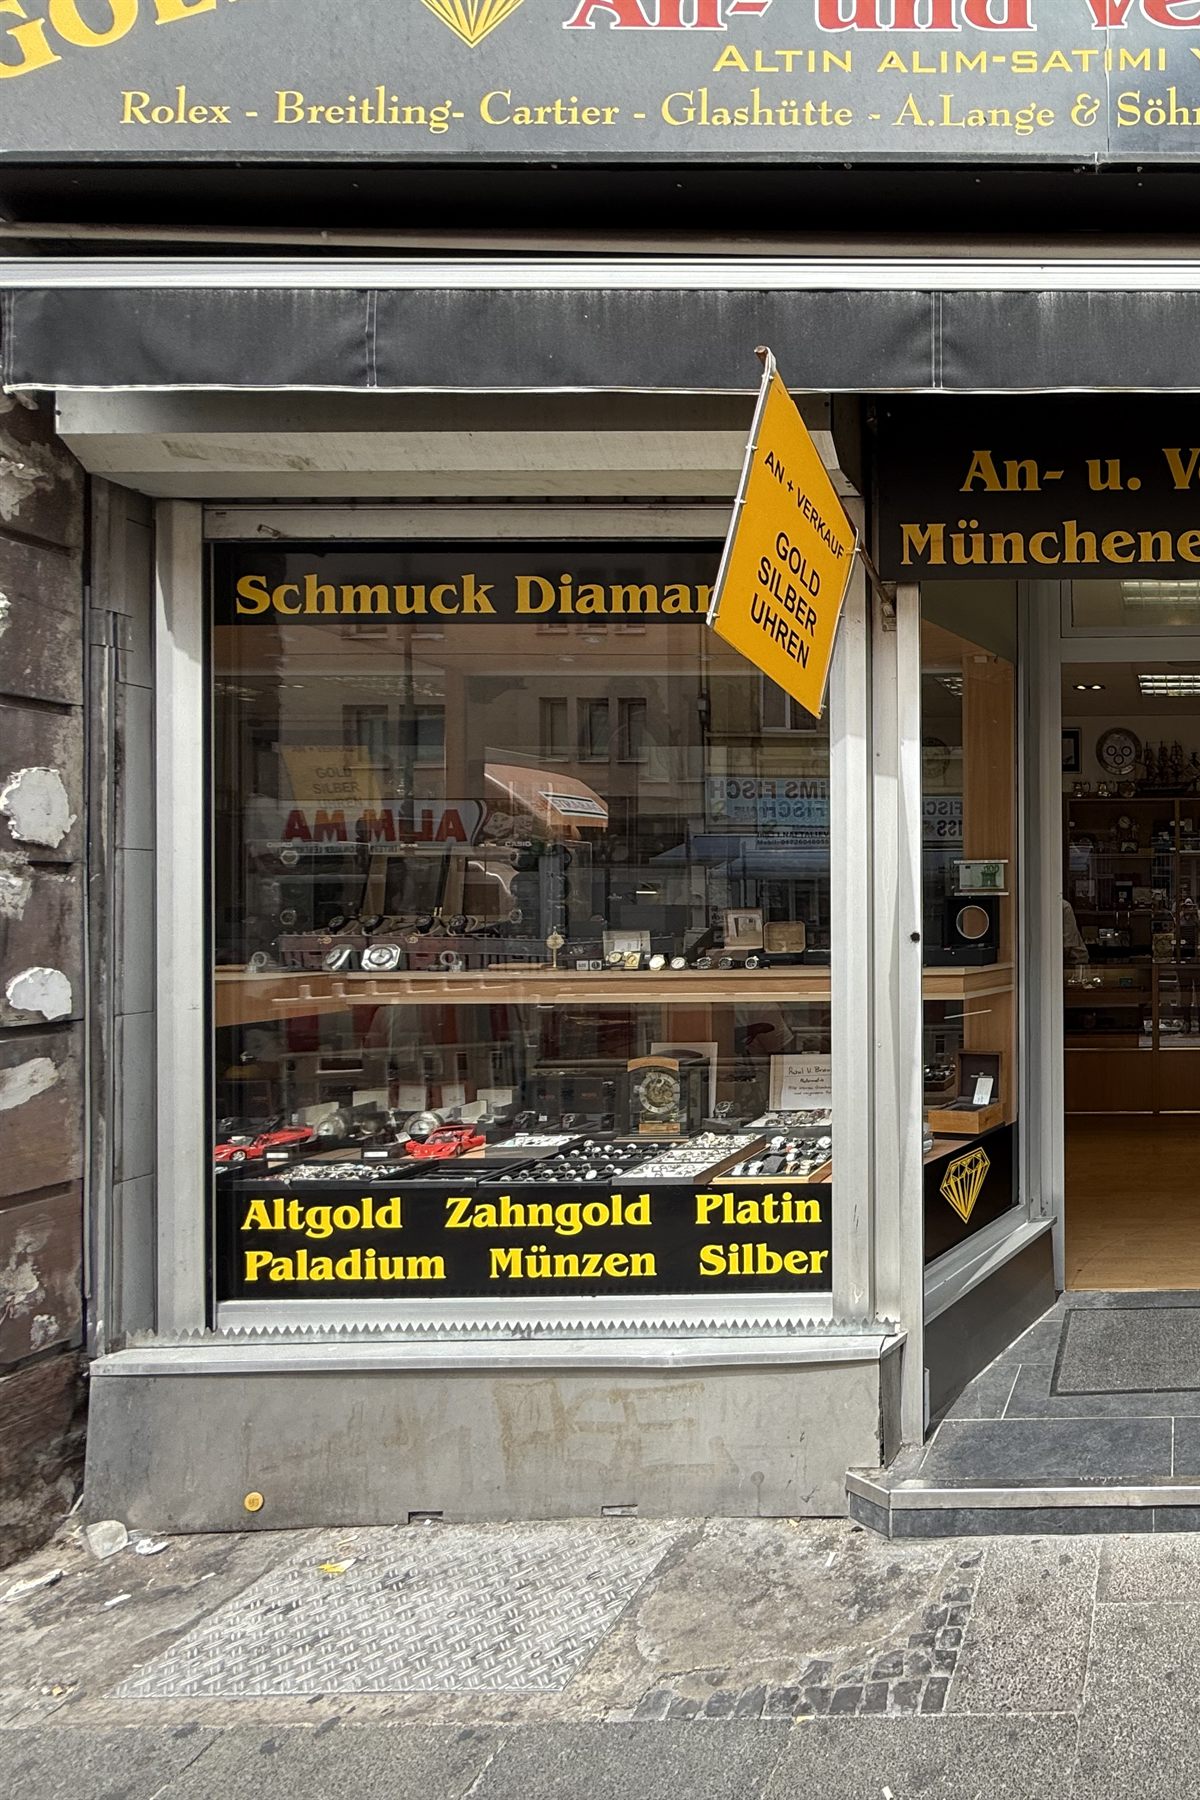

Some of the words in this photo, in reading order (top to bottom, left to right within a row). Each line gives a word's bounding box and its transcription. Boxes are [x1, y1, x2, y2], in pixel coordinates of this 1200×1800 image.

[713, 44, 852, 73] ALTIN
[877, 47, 1167, 74] ALIM-SATIMI
[120, 85, 231, 126] Rolex
[479, 91, 620, 126] Cartier
[660, 86, 853, 127] Glashütte
[891, 94, 1055, 135] A.Lange
[1071, 93, 1100, 127] &
[960, 449, 1064, 492] An-
[1086, 458, 1141, 491] u.
[764, 450, 785, 486] AN
[796, 486, 845, 561] VERKAUF
[775, 531, 821, 598] GOLD
[236, 573, 496, 616] Schmuck
[757, 556, 818, 638] SILBER
[750, 592, 810, 670] UHREN
[240, 1196, 402, 1239] Altgold
[445, 1193, 651, 1236] Zahngold
[695, 1191, 822, 1225] Platin
[244, 1247, 446, 1282] Paladium
[490, 1244, 657, 1279] Münzen
[699, 1242, 828, 1276] Silber
